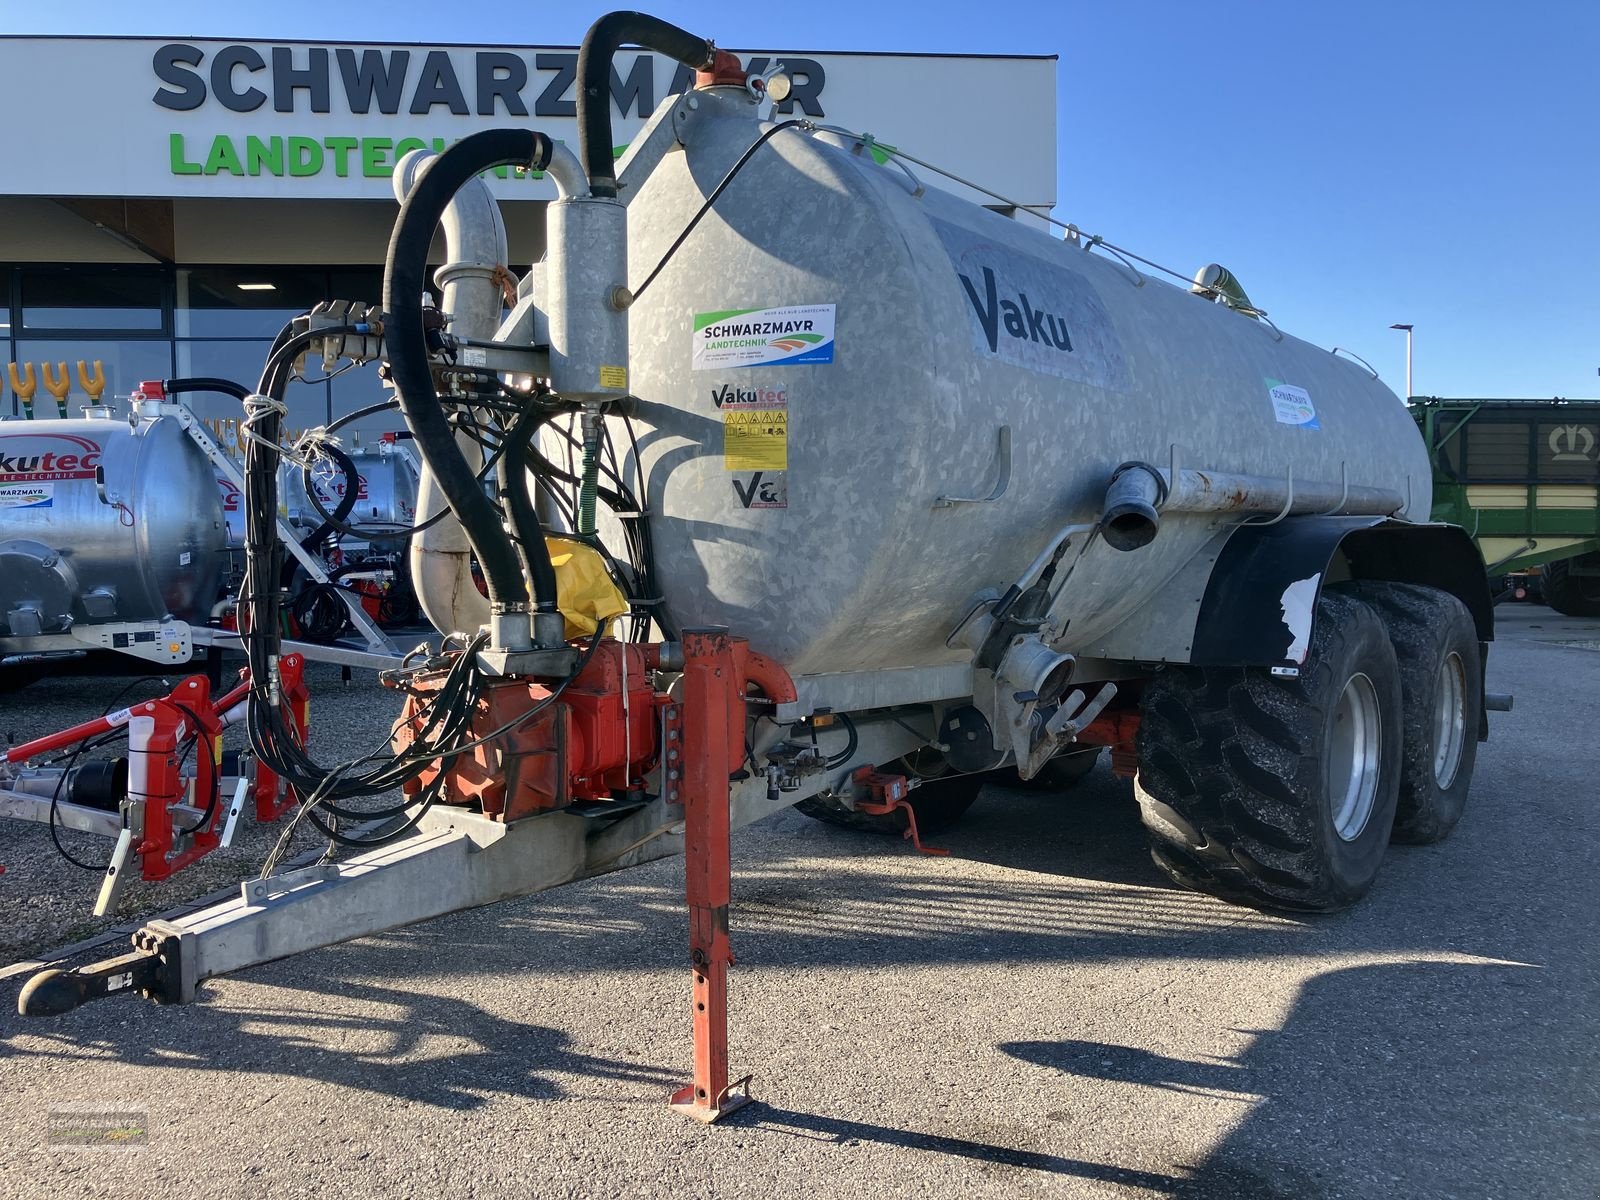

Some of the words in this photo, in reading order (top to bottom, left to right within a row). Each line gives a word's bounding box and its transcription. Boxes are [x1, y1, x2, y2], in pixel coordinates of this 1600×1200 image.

[958, 265, 1074, 353] Vaku
[704, 320, 814, 339] SCHWARZMAYR
[705, 338, 768, 350] LANDTECHNIK
[711, 384, 786, 408] Vakutec
